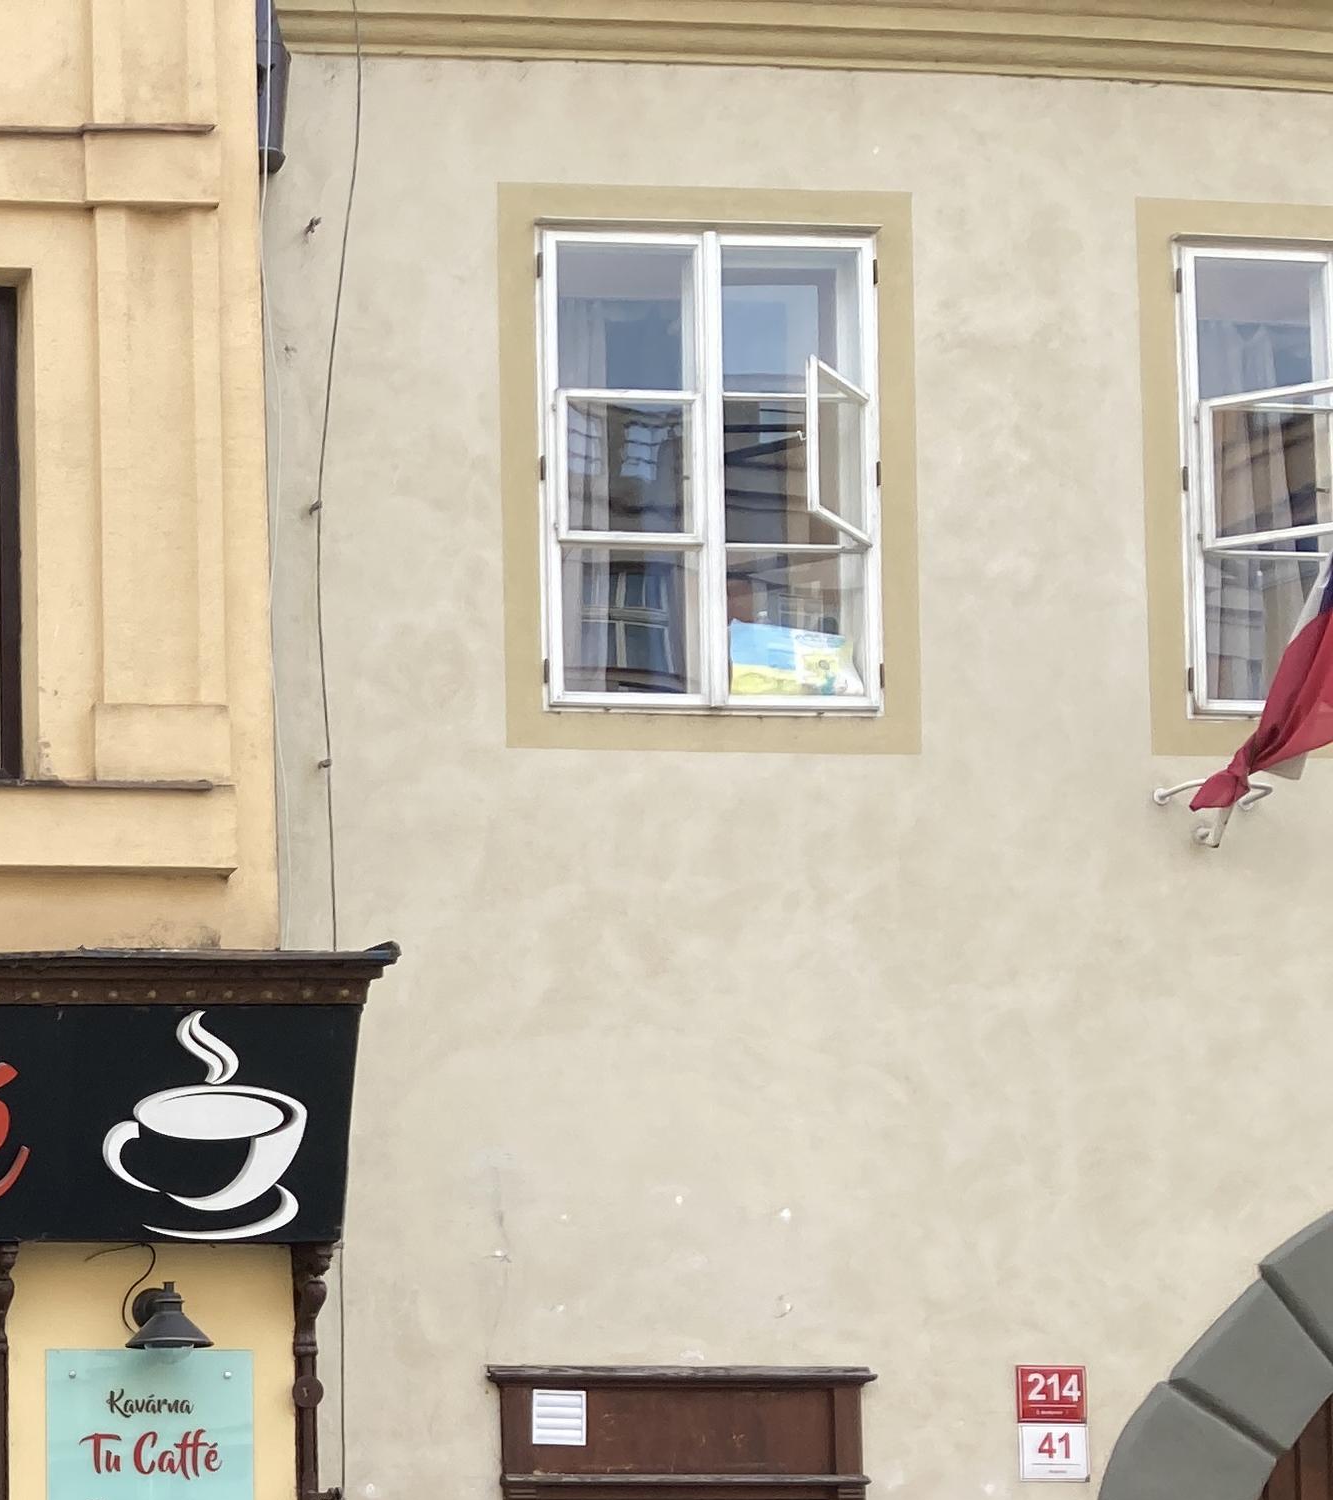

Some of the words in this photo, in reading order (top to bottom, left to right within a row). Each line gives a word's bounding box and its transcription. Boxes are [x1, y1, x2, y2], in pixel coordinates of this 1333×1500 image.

[1027, 1373, 1082, 1402] 214
[106, 1388, 194, 1418] Kavárna
[79, 1432, 122, 1474] Tu
[133, 1429, 223, 1480] Caffé
[1038, 1432, 1071, 1459] 41
